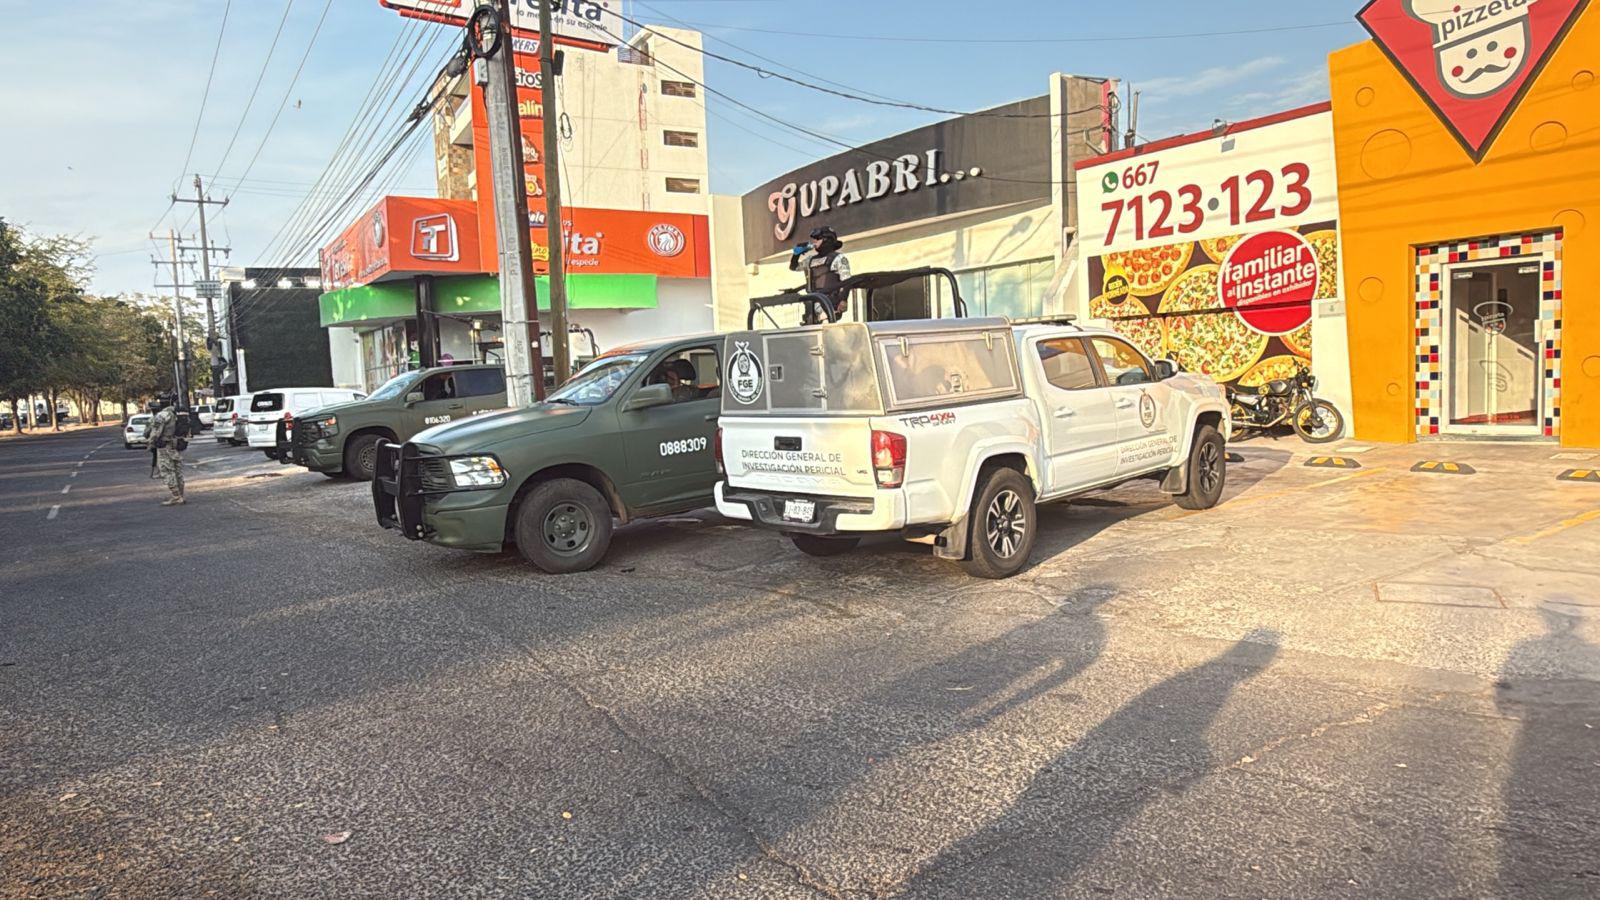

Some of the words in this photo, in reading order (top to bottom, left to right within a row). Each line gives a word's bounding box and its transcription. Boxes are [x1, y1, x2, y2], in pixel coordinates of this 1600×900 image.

[1122, 160, 1160, 189] 667
[1225, 244, 1307, 284] familiar
[1226, 286, 1236, 298] al
[1236, 262, 1315, 299] instante
[738, 380, 753, 388] FGE
[899, 415, 931, 429] TRD
[659, 436, 707, 456] 0888309
[1169, 434, 1178, 444] DE
[785, 452, 827, 462] GENERAL
[828, 453, 842, 463] DE
[804, 465, 847, 476] PERICIAL
